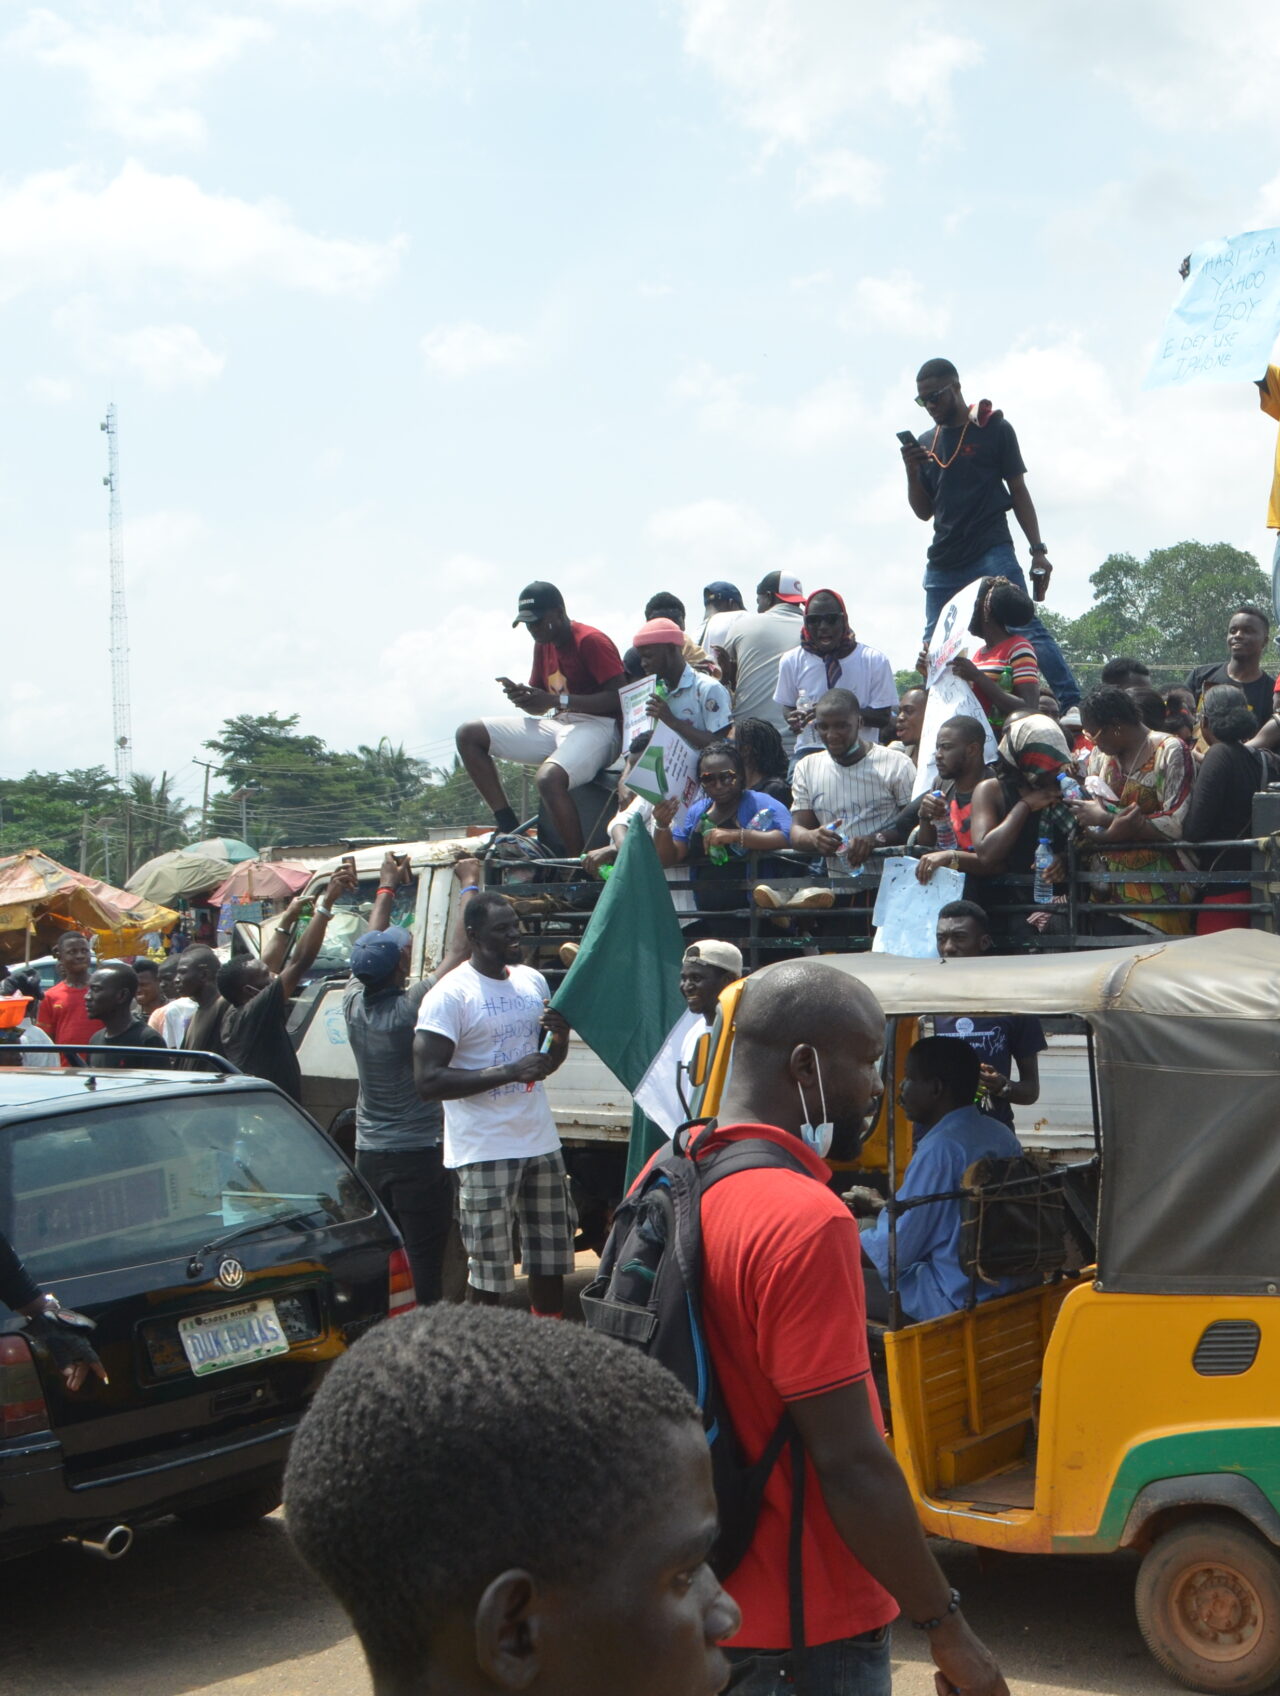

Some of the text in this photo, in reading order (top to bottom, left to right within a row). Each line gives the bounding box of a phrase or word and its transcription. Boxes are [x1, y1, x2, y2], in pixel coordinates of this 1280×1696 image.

[1265, 240, 1276, 255] A
[1211, 270, 1266, 302] YAHOO
[1213, 297, 1262, 331] BOY
[203, 1313, 228, 1325] CROSS
